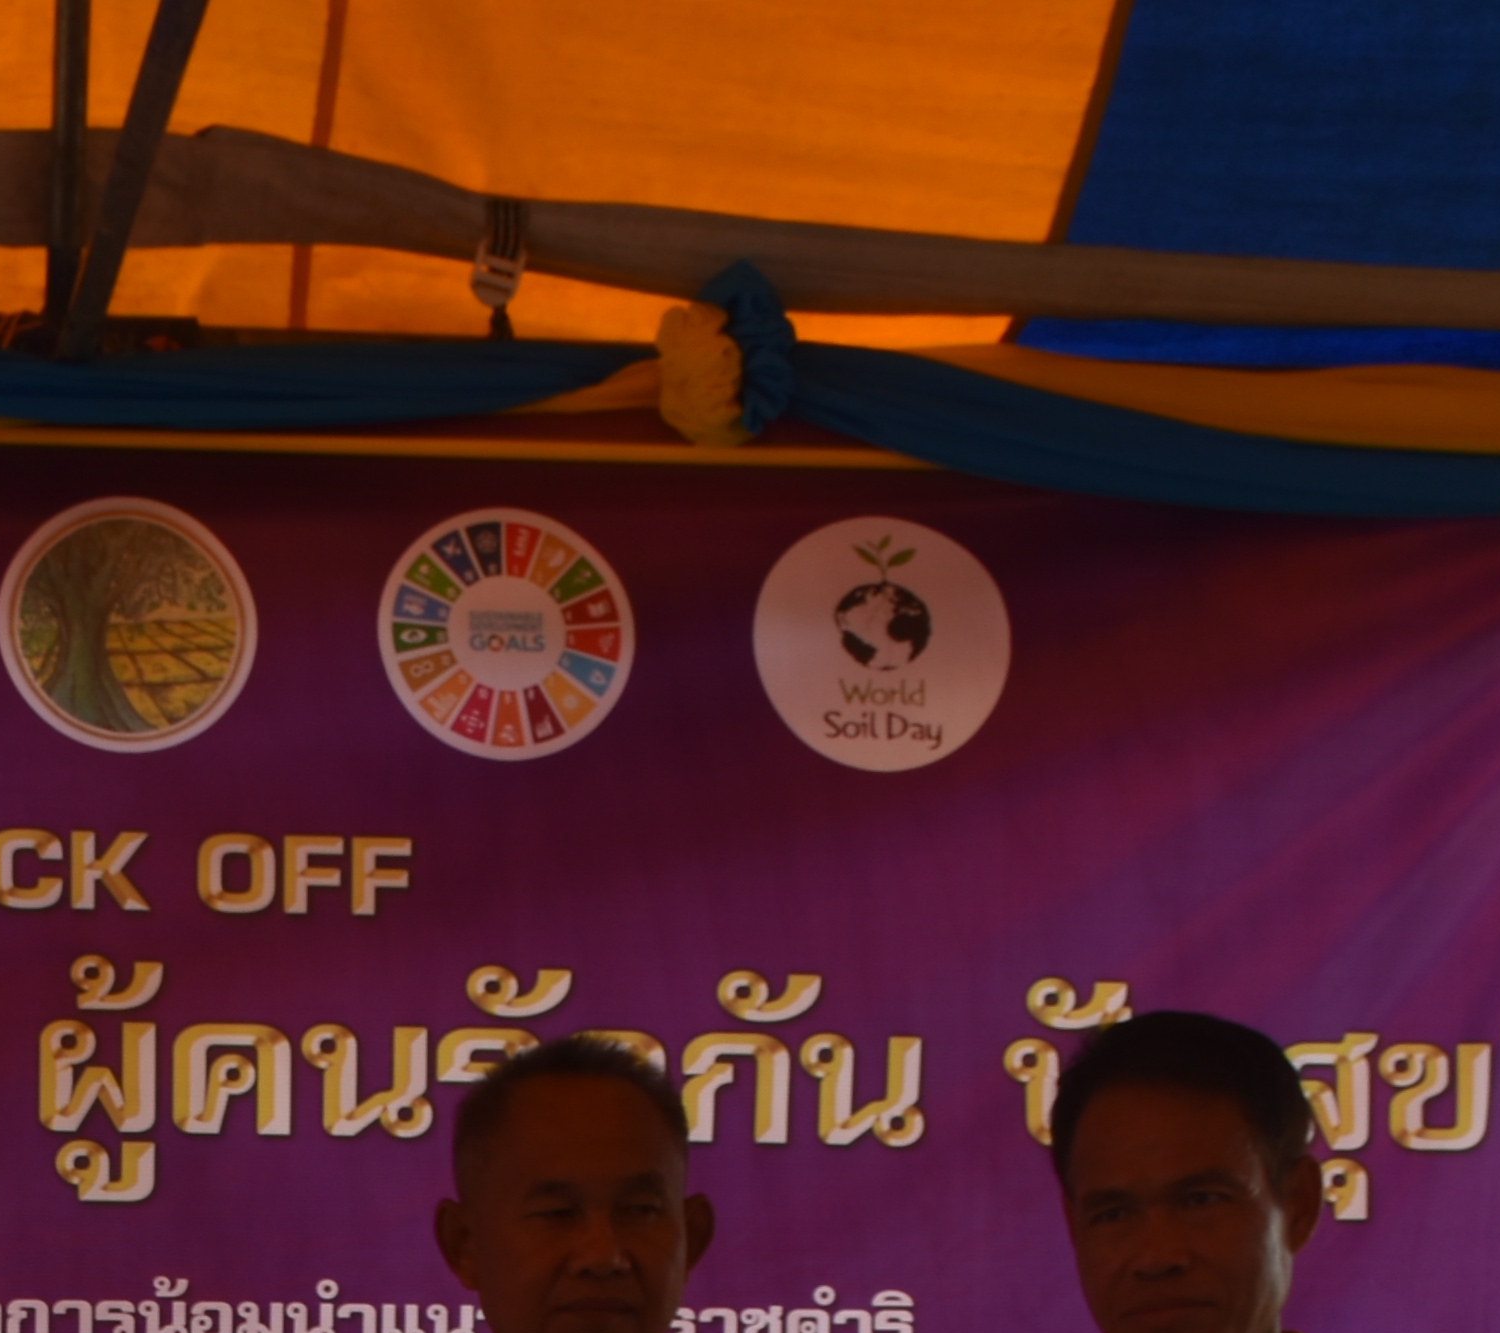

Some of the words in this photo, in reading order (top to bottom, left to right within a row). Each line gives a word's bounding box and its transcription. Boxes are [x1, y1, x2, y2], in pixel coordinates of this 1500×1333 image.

[469, 633, 545, 652] GOALS
[839, 678, 926, 707] World
[823, 711, 878, 739] Soil
[886, 712, 943, 750] Day
[196, 832, 413, 915] OFF
[38, 953, 924, 1201] ผู้คนรักัน
